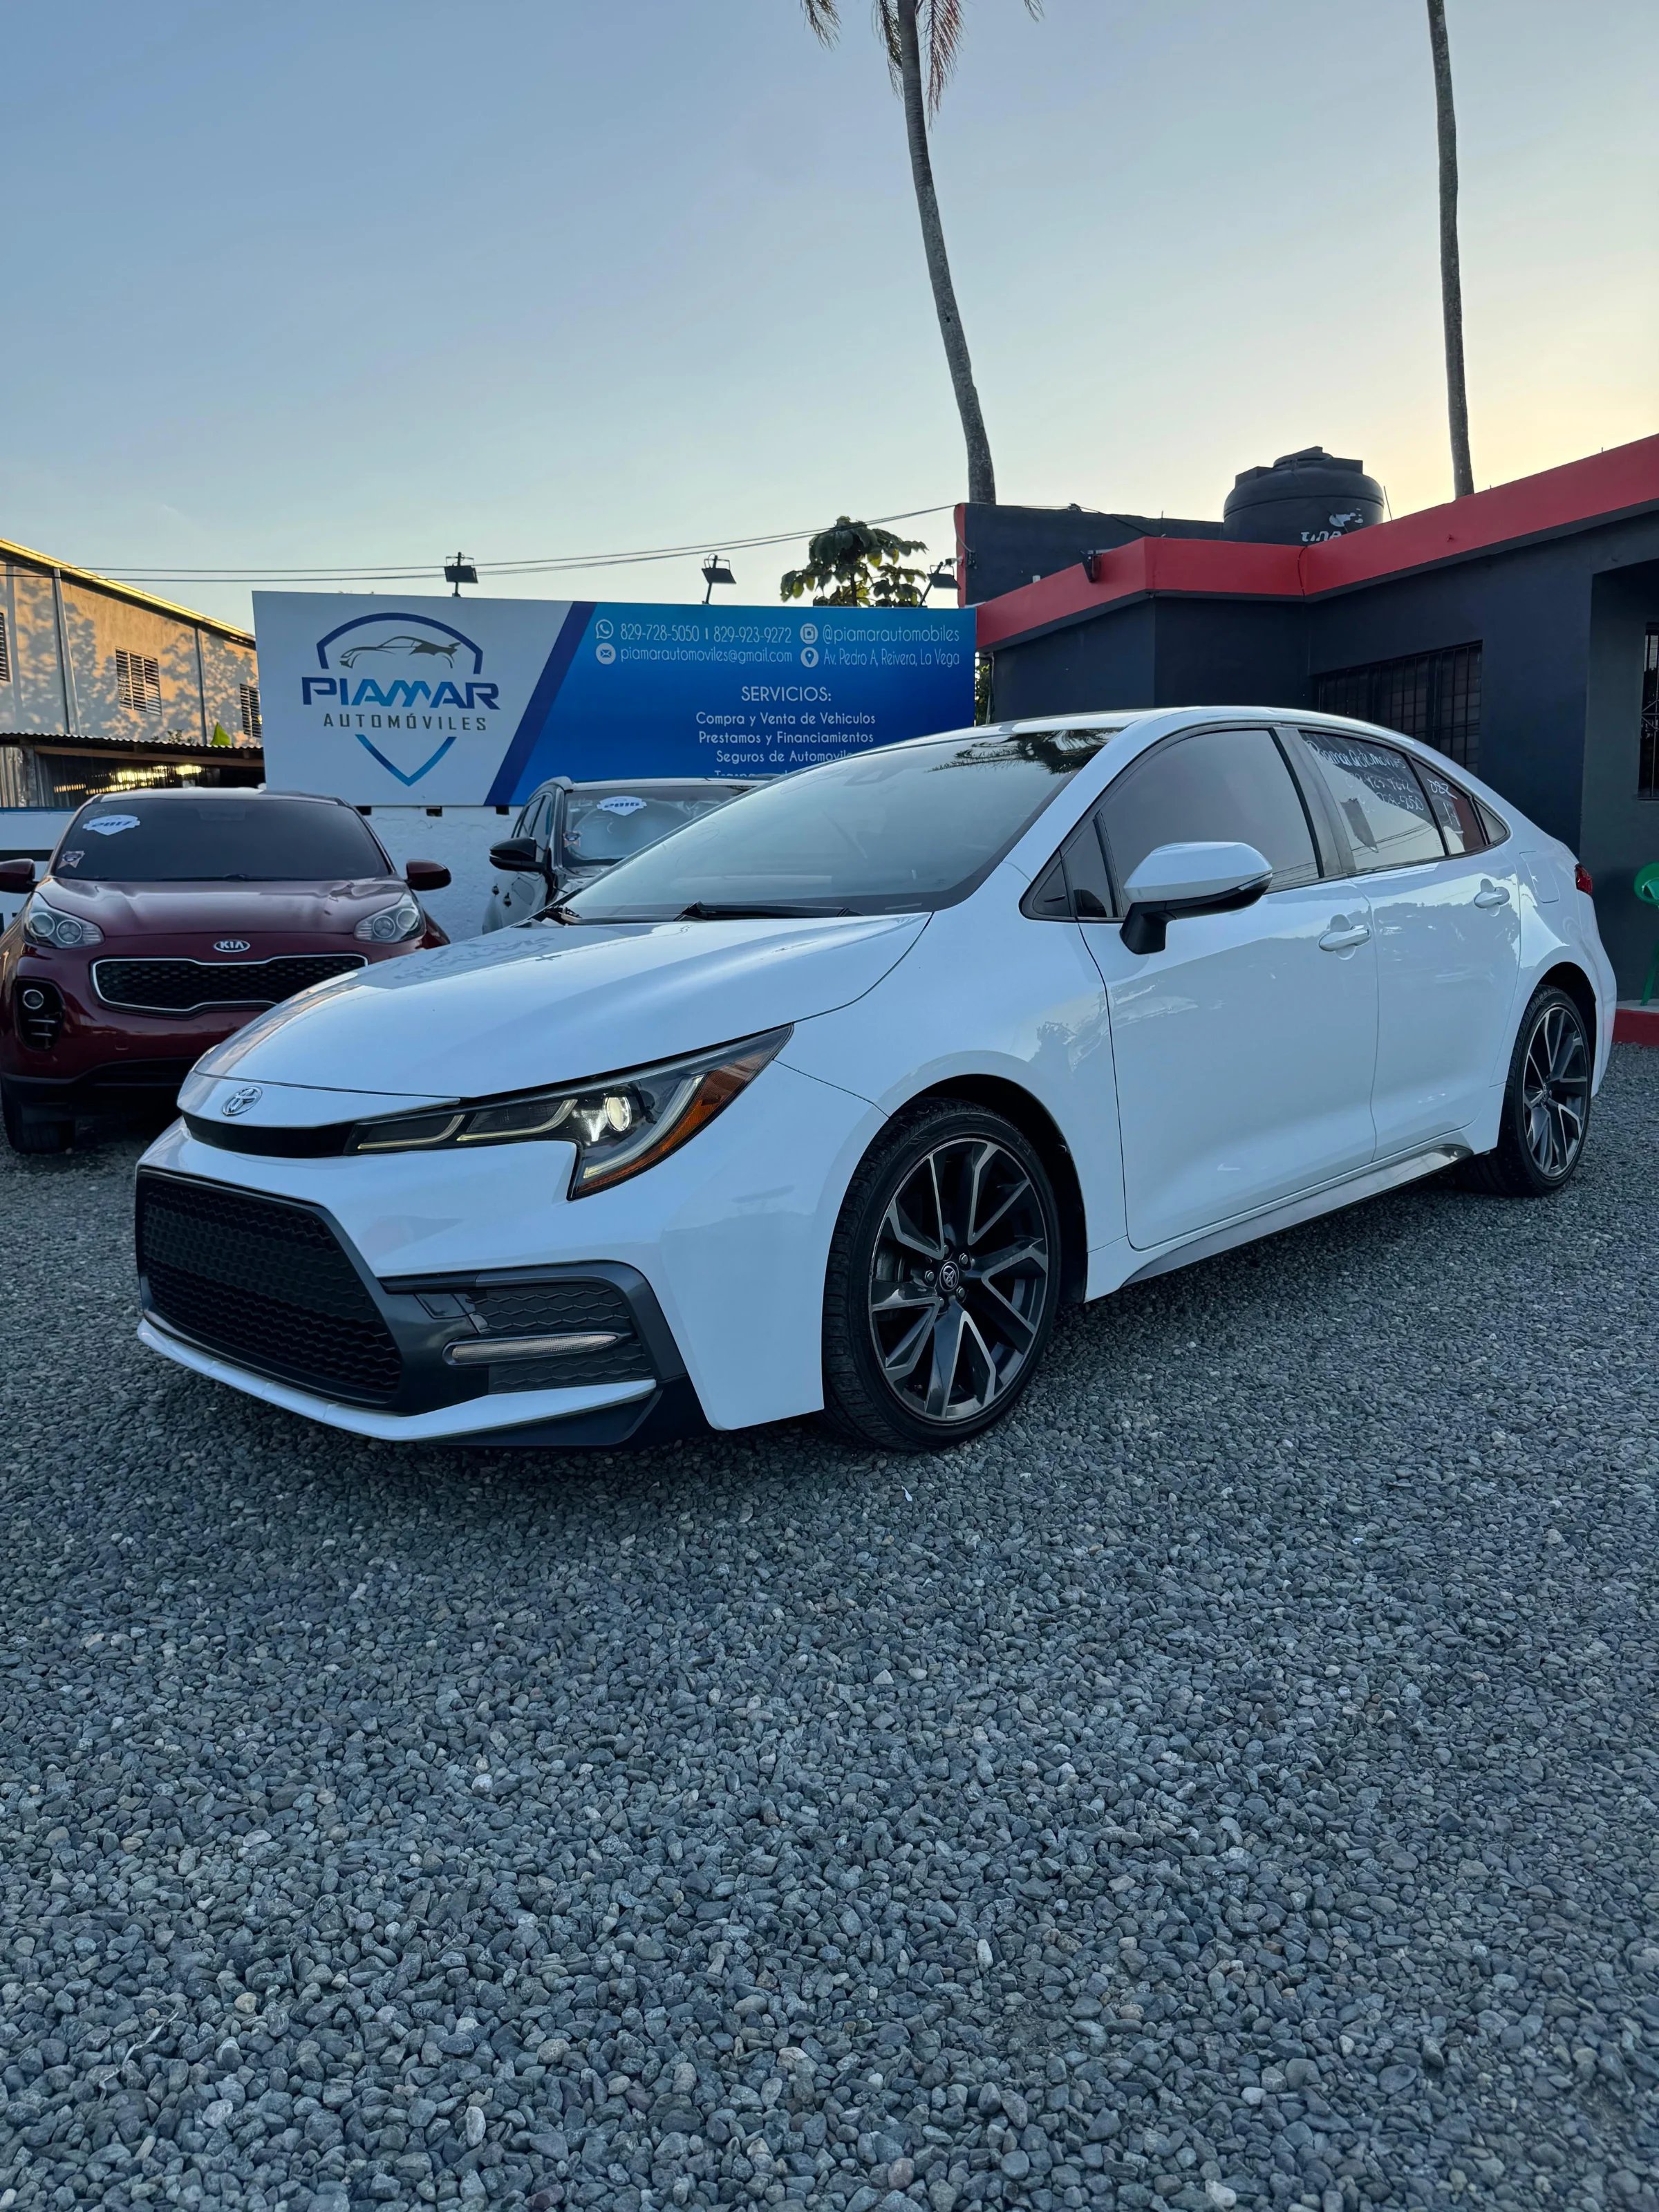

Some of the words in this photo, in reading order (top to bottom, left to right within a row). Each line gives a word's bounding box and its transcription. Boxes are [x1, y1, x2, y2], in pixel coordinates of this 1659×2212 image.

[620, 623, 700, 641] 829-728-5050
[713, 626, 791, 643] 829-923-9272
[823, 624, 959, 644] @piamarautomobiles
[621, 647, 792, 664] piamarautomoviles@gmail.com
[823, 648, 836, 666] Av.
[838, 648, 867, 666] Pedro
[881, 648, 917, 666] Reivera,
[921, 648, 932, 665] La
[935, 648, 959, 668] Vega
[301, 676, 501, 711] PIAMAR
[740, 686, 832, 702] SERVICIOS:
[324, 712, 487, 731] AUTOMÓVILES
[696, 711, 744, 727] Compra
[749, 715, 756, 727] y
[760, 712, 796, 724] Venta
[800, 712, 816, 724] de
[820, 712, 876, 724] Vehiculos
[699, 731, 761, 744] Prestamos
[765, 733, 772, 746] y
[777, 731, 874, 743] Financiamientos
[716, 750, 765, 765] Seguros
[769, 750, 785, 762] de
[219, 940, 245, 949] KIA
